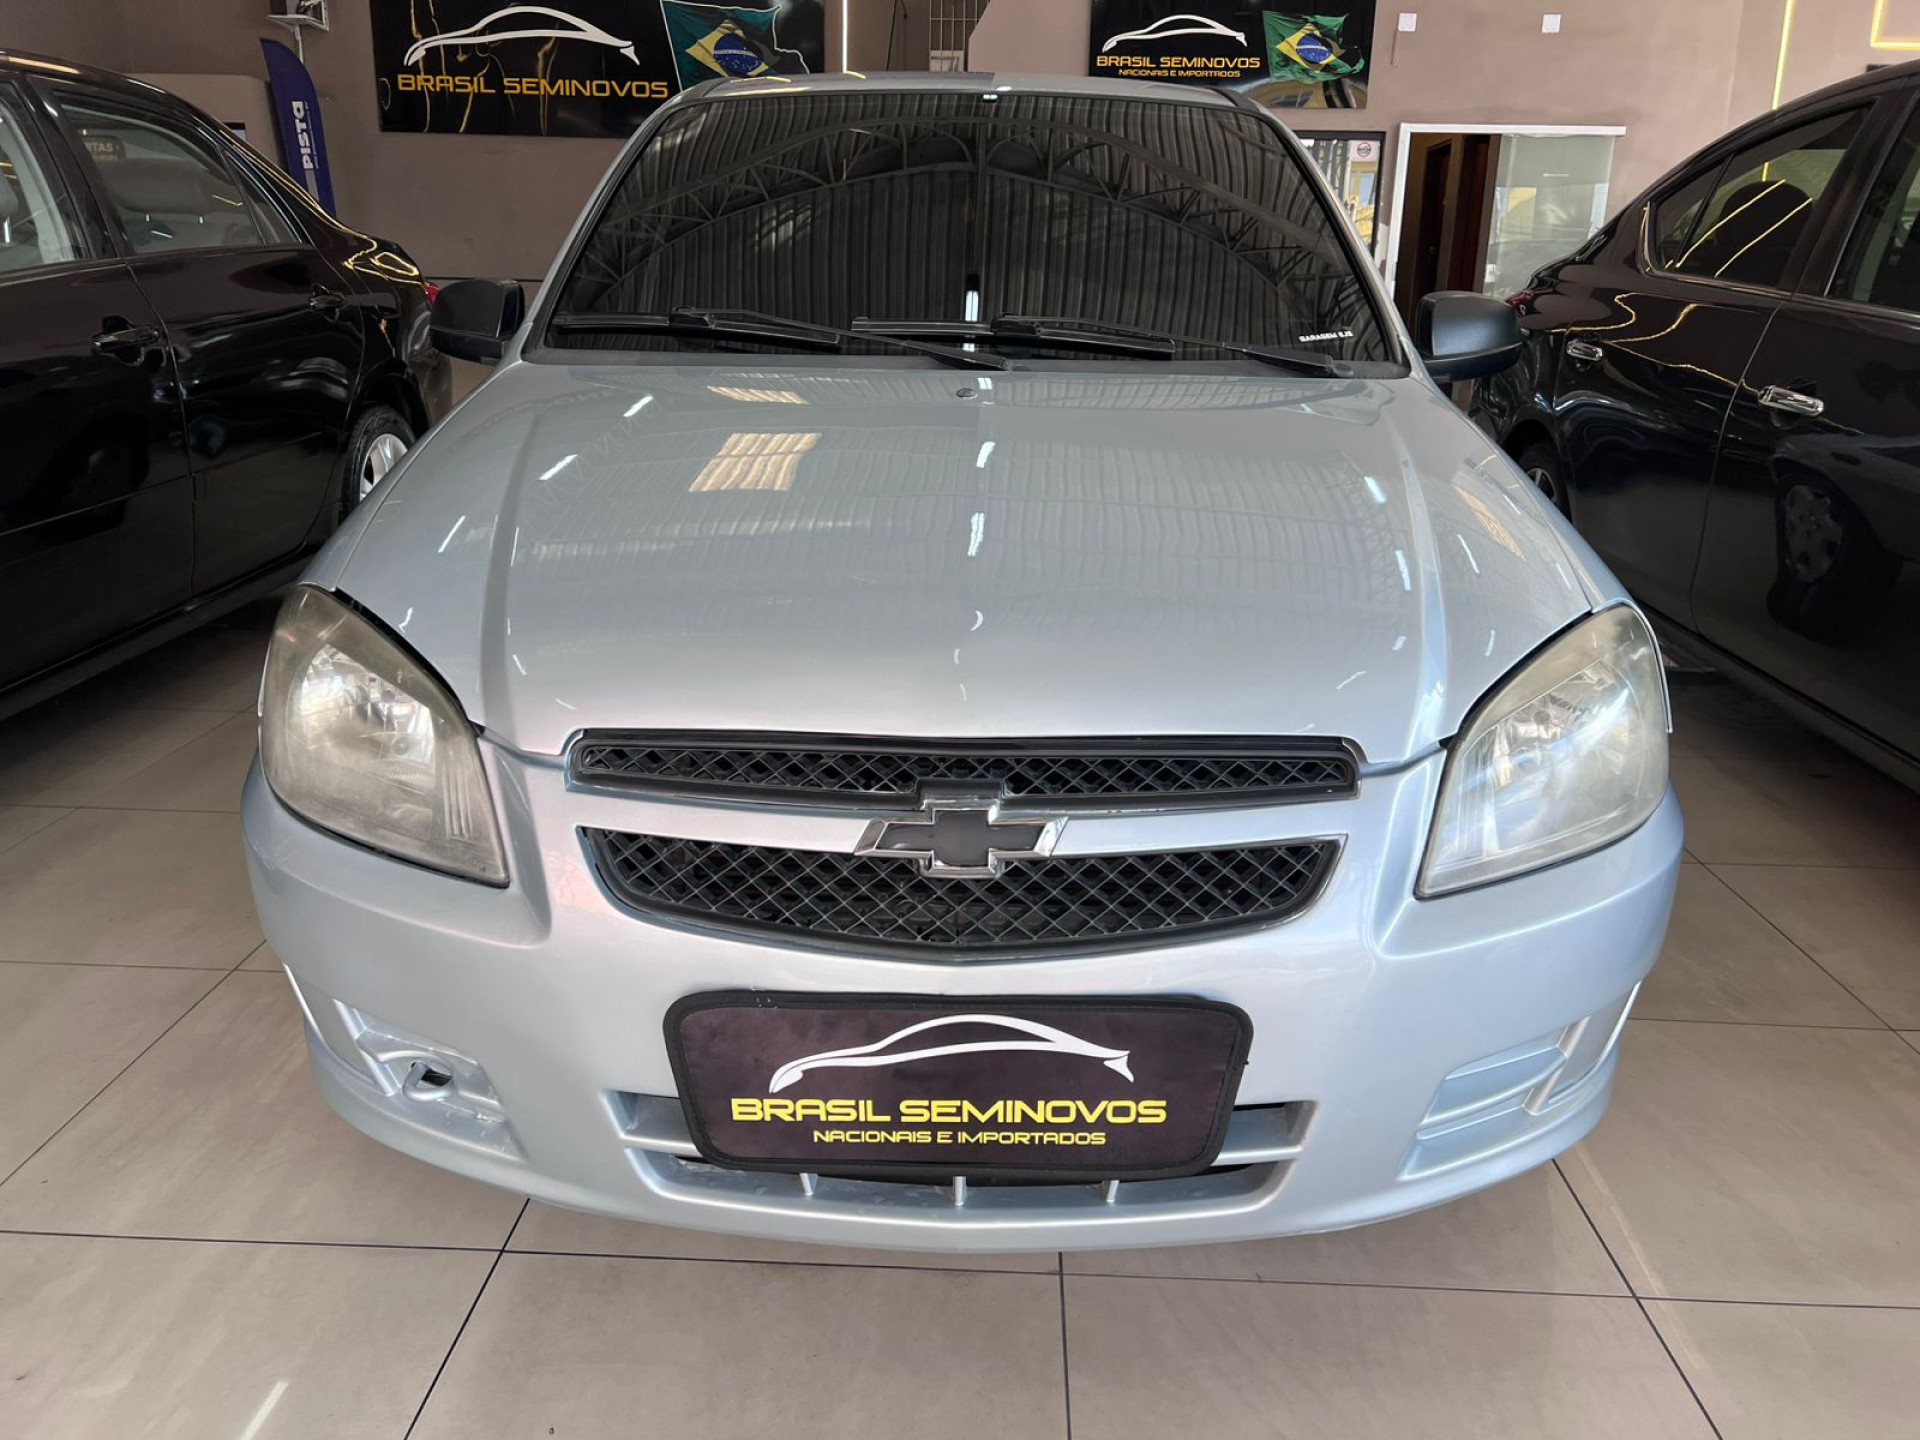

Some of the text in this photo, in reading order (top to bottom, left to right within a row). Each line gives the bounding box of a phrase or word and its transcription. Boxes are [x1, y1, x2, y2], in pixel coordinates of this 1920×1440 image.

[1096, 55, 1261, 69] BRASIL SEMINOVOS
[1178, 70, 1241, 78] IMPORTADOS
[397, 74, 669, 98] BRASIL SEMINOVOS
[731, 1097, 1168, 1124] BRASIL SEMINOVOS
[813, 1129, 1107, 1146] NACIONAIS E IMPORTADOS
